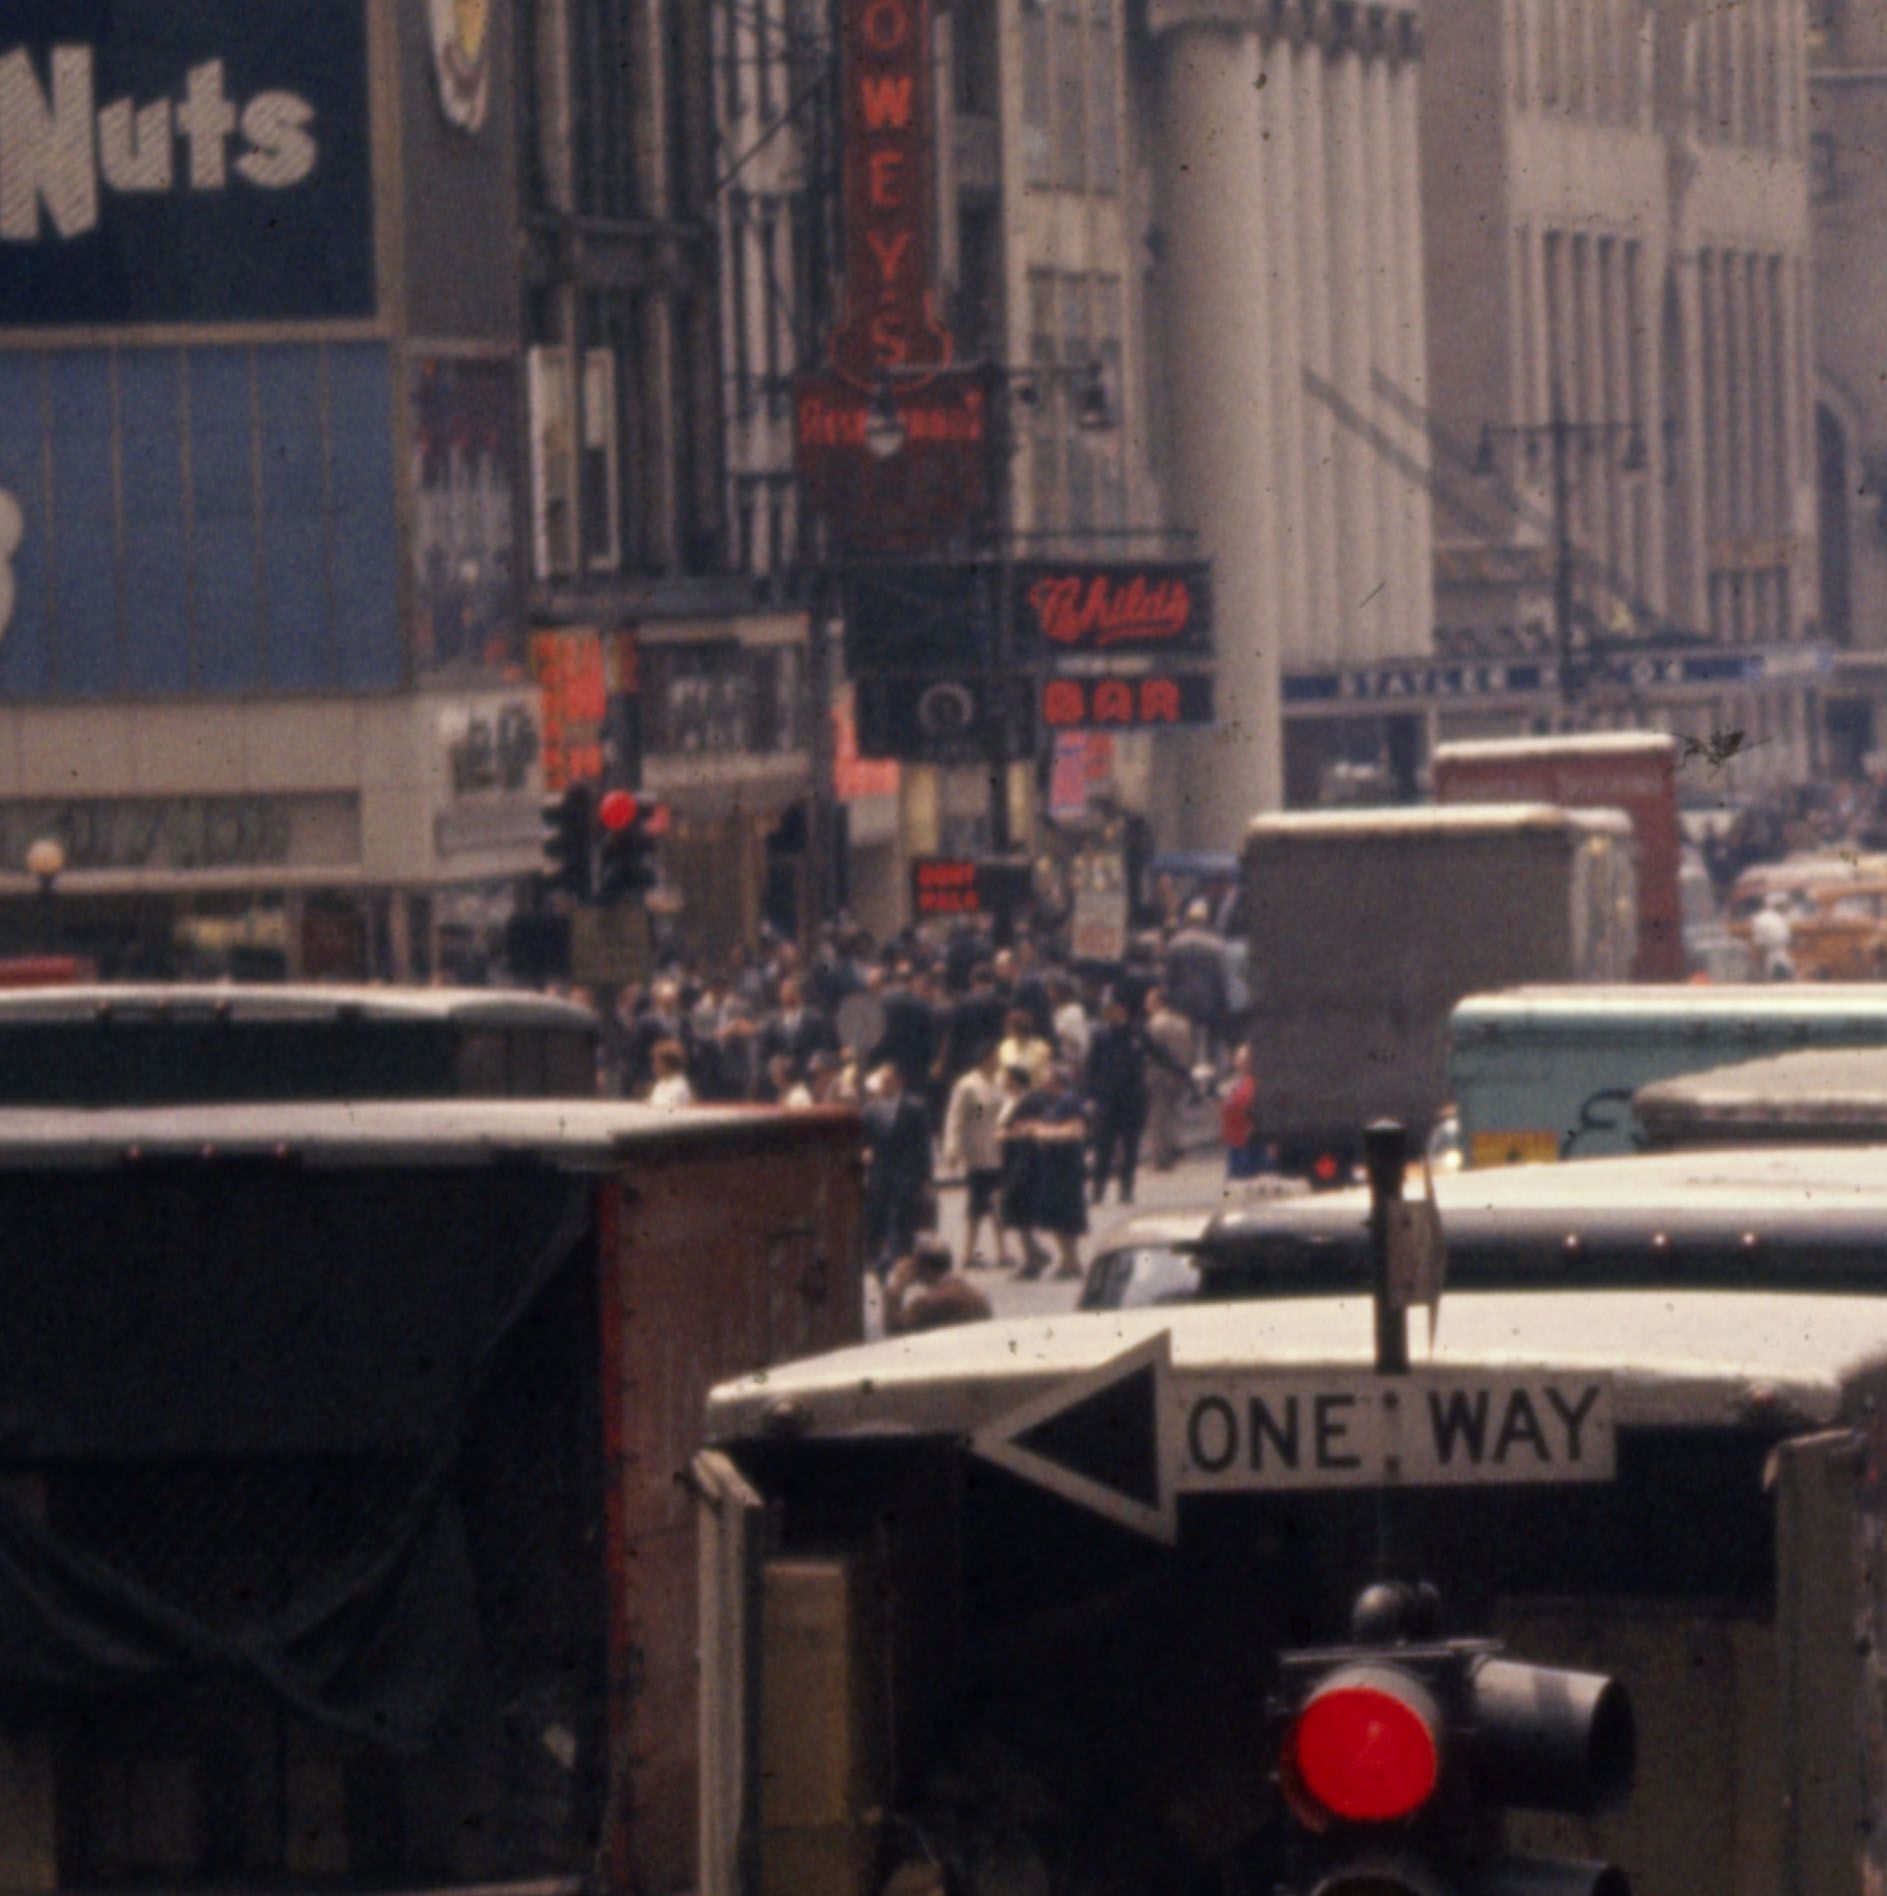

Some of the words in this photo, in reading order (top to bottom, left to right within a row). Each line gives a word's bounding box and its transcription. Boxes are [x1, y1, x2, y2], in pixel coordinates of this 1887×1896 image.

[0, 43, 316, 241] Nuts
[1043, 677, 1181, 724] BAR
[1188, 1395, 1358, 1472] ONE
[1429, 1388, 1599, 1463] WAY
